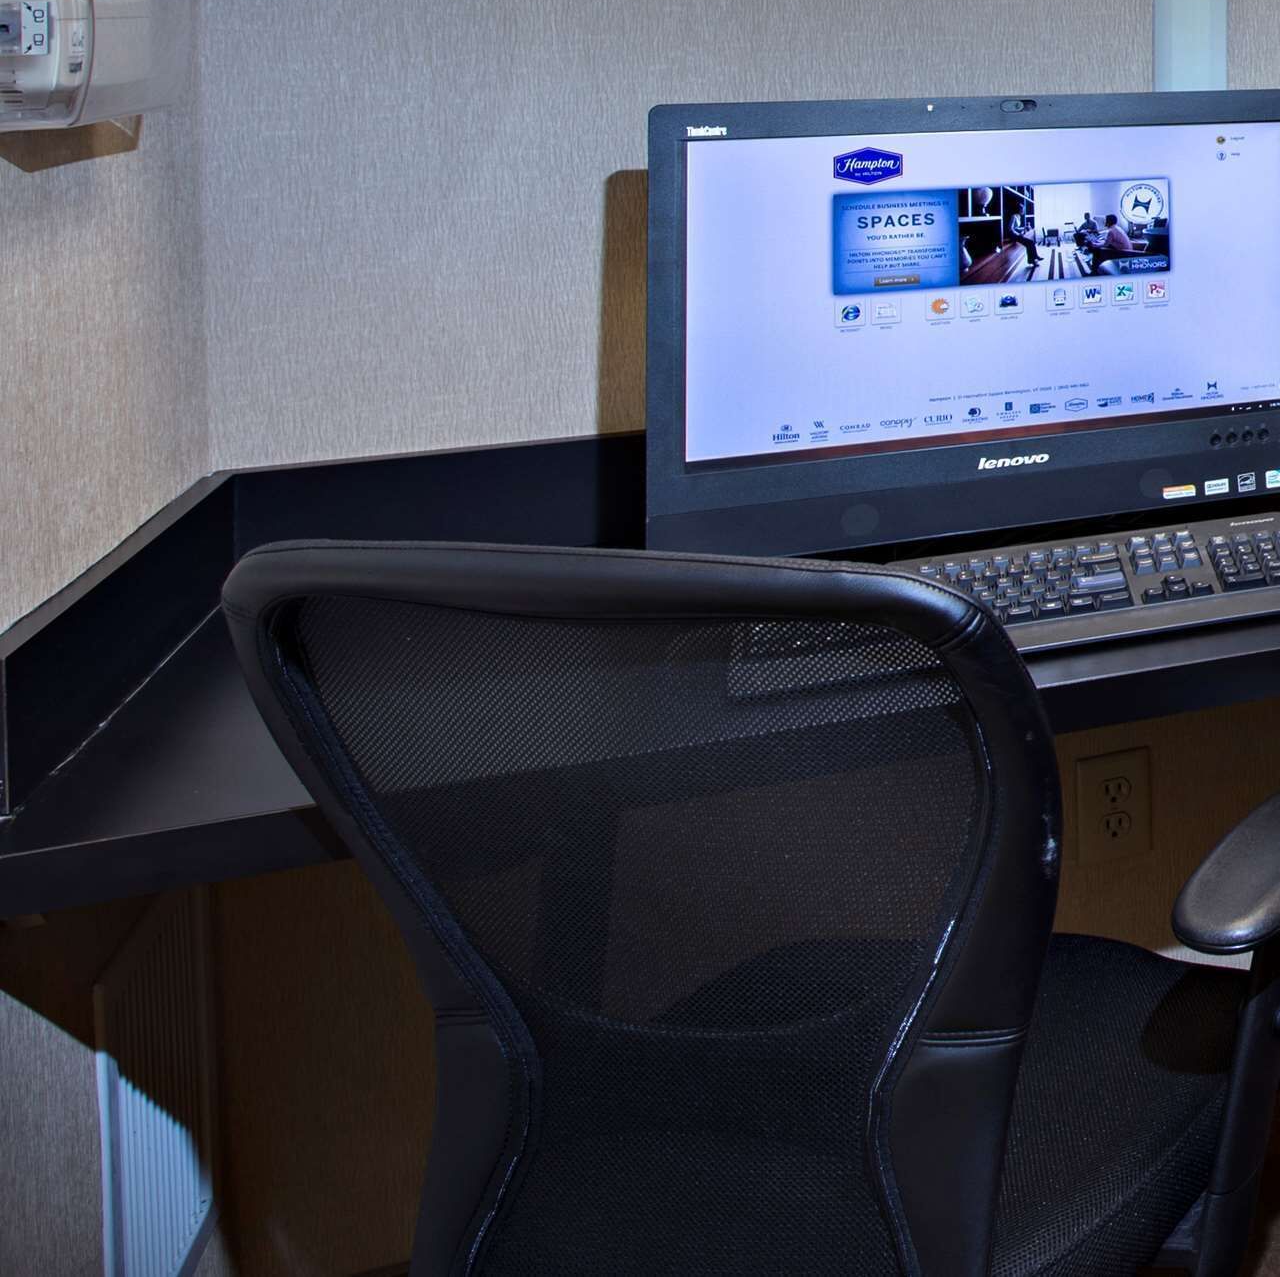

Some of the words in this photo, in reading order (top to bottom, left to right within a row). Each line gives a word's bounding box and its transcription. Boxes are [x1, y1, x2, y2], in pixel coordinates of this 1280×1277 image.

[836, 156, 900, 174] Hampton
[857, 212, 935, 229] SPACES
[772, 432, 800, 441] Hilton
[978, 453, 1050, 470] lenovo
